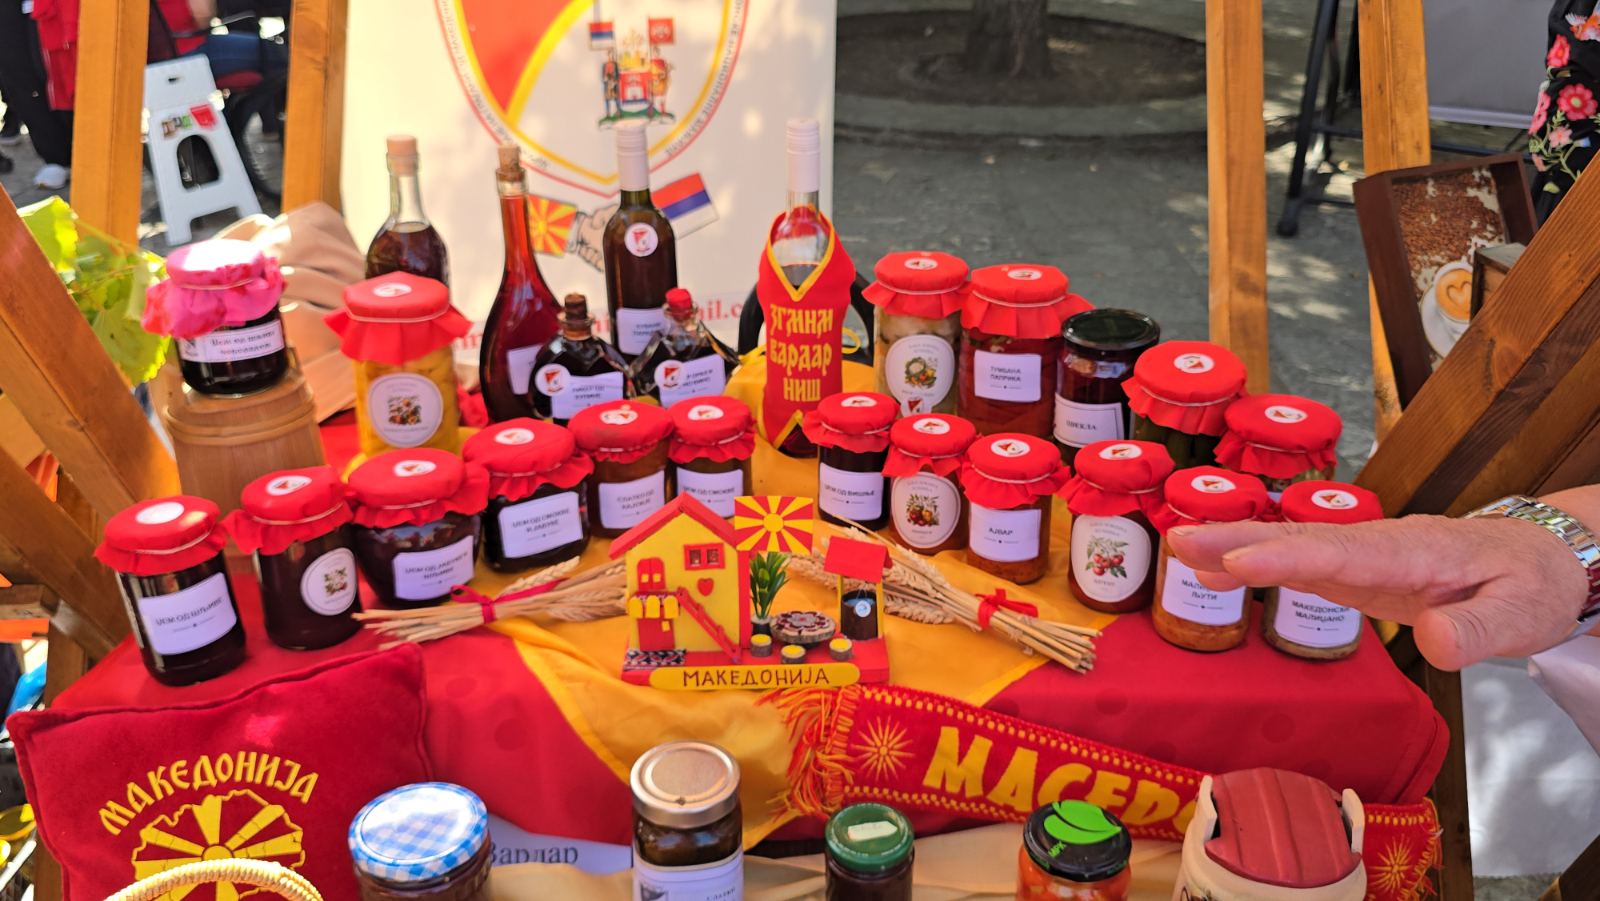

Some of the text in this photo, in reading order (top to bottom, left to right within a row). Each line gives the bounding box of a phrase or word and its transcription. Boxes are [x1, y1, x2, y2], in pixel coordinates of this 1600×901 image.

[990, 374, 1022, 383] ПАПРИКА
[988, 527, 1013, 537] АЈВАР
[1192, 591, 1218, 600] ЉУТИ
[683, 667, 829, 687] МАКЕДОНИЈА
[98, 750, 319, 836] МАКЕДОНИЈА
